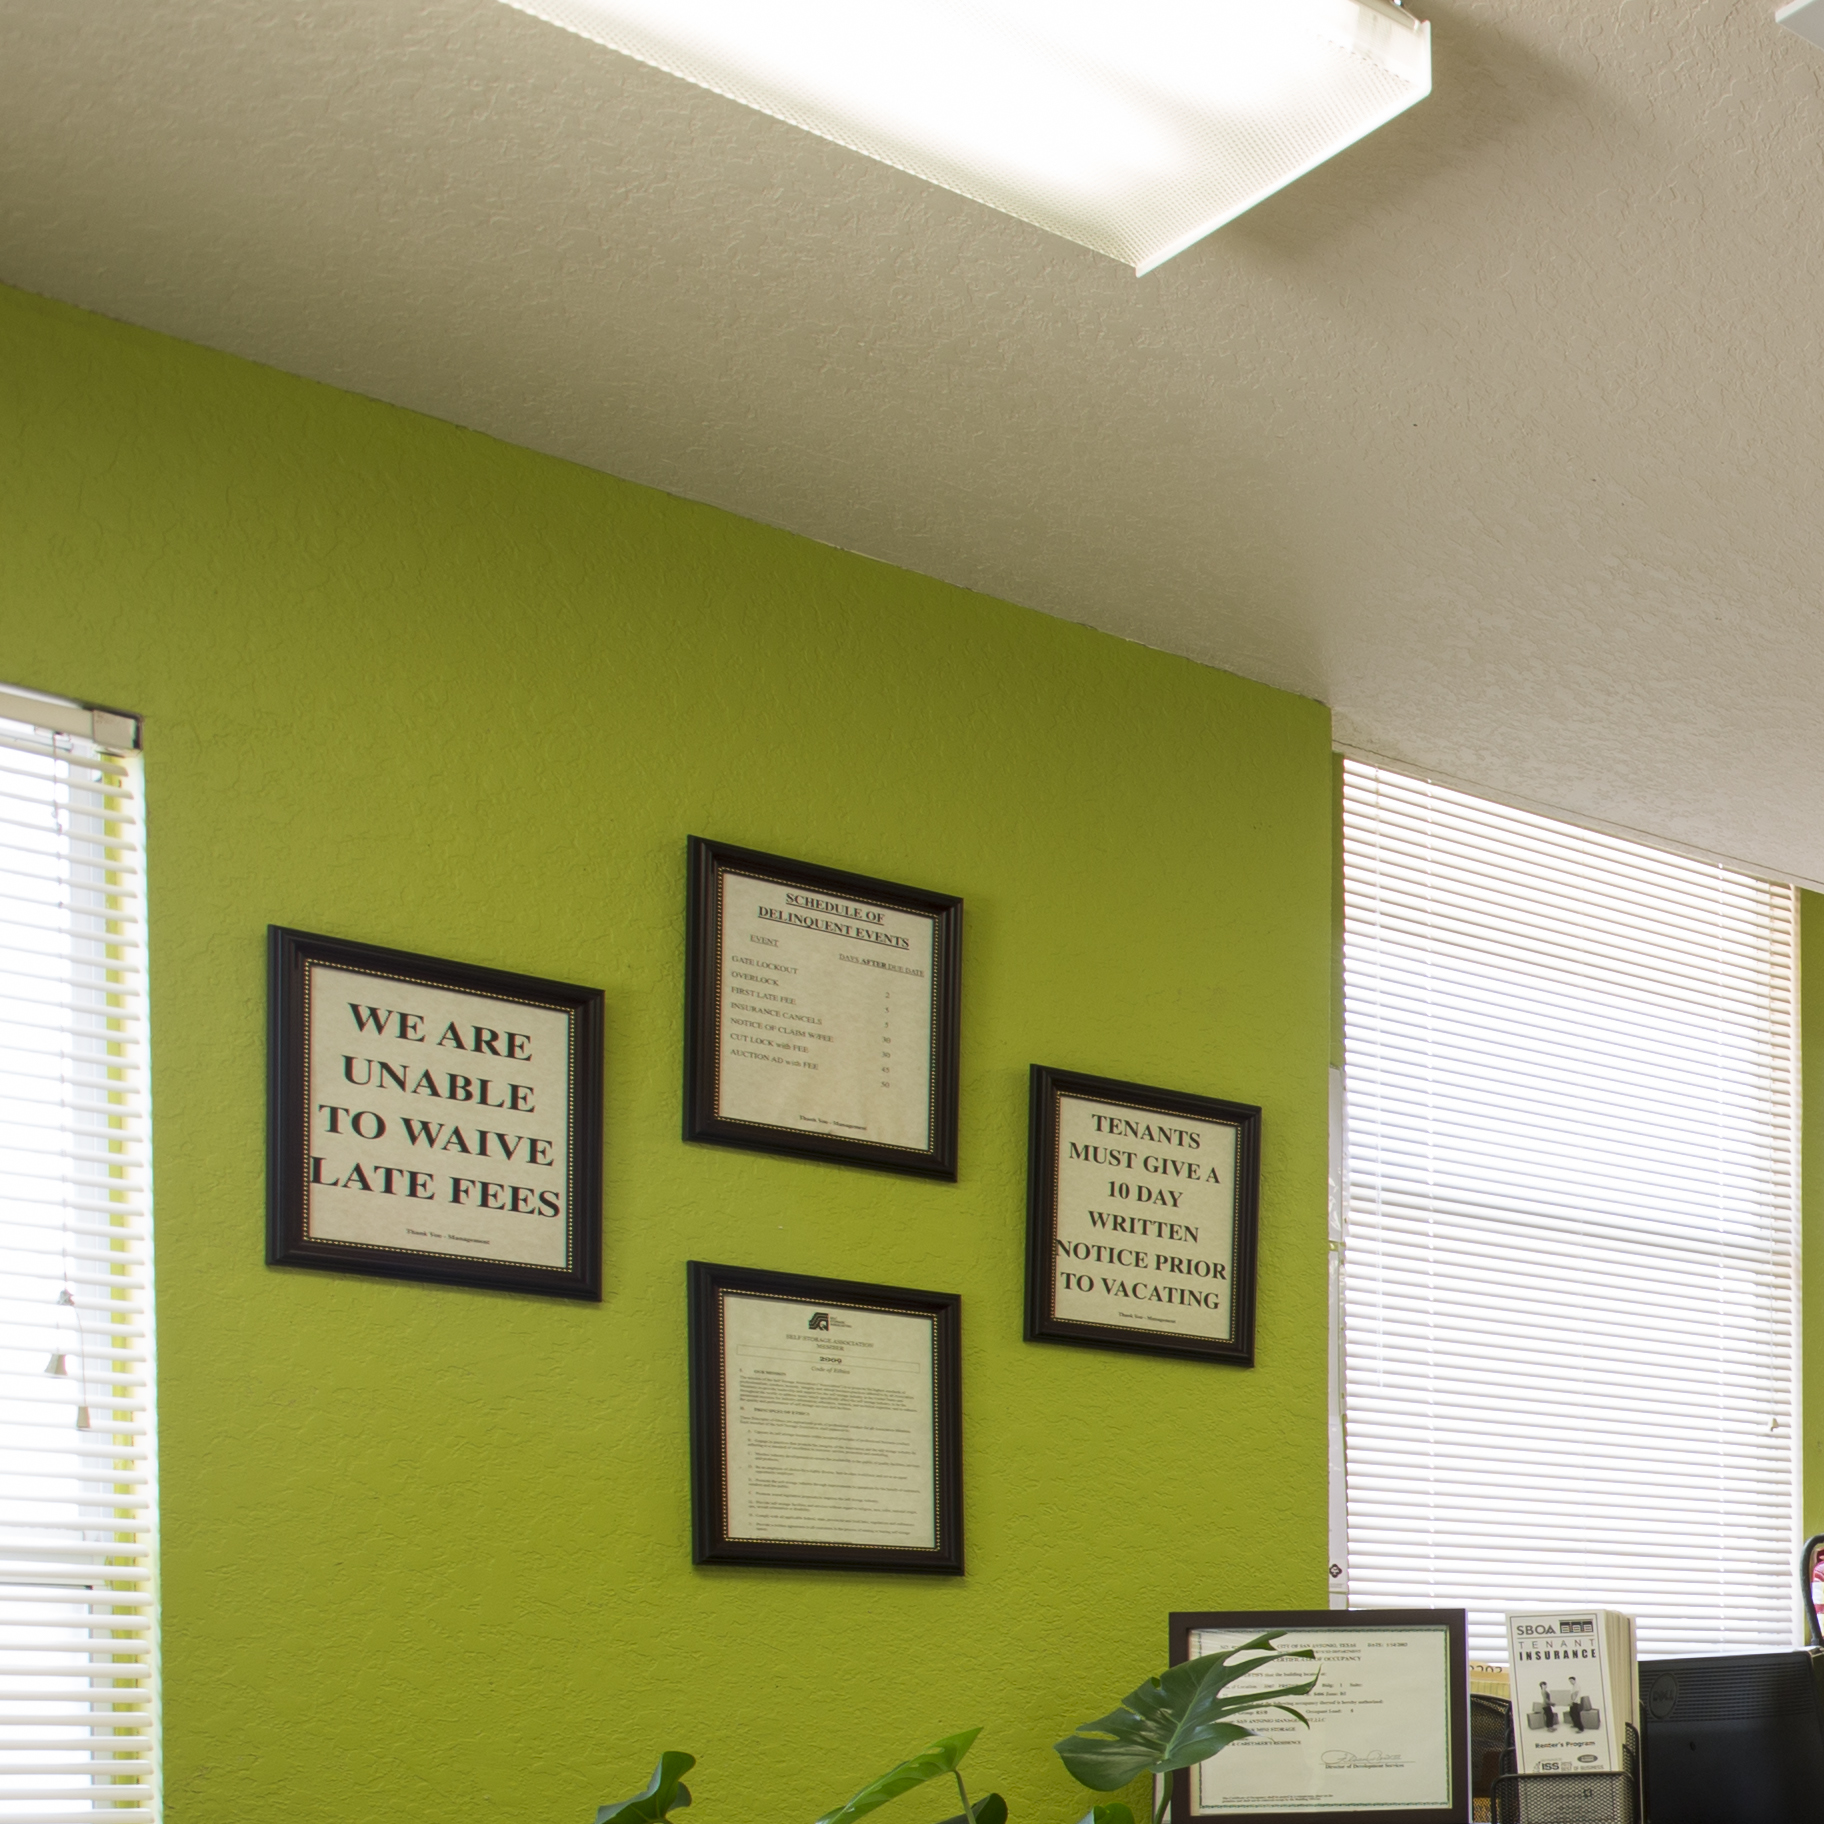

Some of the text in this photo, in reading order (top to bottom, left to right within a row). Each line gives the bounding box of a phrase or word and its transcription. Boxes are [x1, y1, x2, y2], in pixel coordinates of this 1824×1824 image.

[785, 893, 885, 924] SCHEDULE OF
[758, 906, 909, 949] DELINQUENT EVENTS
[750, 934, 779, 947] EVENT
[732, 955, 798, 974] GATE LOCKOUT
[839, 954, 924, 978] DAYS AFTER DUE DATE
[731, 971, 779, 986] OVERLOCK
[731, 986, 796, 1006] FIRST LATE FEE
[730, 1002, 822, 1025] INSURANCE CANCELS
[348, 1002, 533, 1062] WE ARE
[730, 1018, 762, 1029] NOTICE
[778, 1027, 806, 1037] CLAIM
[730, 1033, 748, 1042] CUT
[750, 1036, 774, 1047] LOCK
[793, 1045, 809, 1054] FEE
[730, 1049, 770, 1060] AUCTION
[771, 1056, 784, 1064] AD
[803, 1062, 818, 1070] FEE
[342, 1054, 536, 1113] UNABLE
[318, 1104, 555, 1167] TO WAIVE
[1092, 1114, 1200, 1150] TENANTS
[1069, 1142, 1220, 1184] MUST GIVE A
[310, 1156, 561, 1218] LATE FEES
[1107, 1180, 1184, 1208] 10 DAY
[1088, 1210, 1199, 1244] WRITTEN
[1056, 1240, 1228, 1280] NOTICE PRIOR
[1060, 1272, 1220, 1310] TO VACATING
[1516, 1624, 1556, 1636] SBOA
[1518, 1638, 1595, 1650] TENANT
[1519, 1648, 1596, 1661] INSURANCE
[1542, 1762, 1560, 1770] ISS
